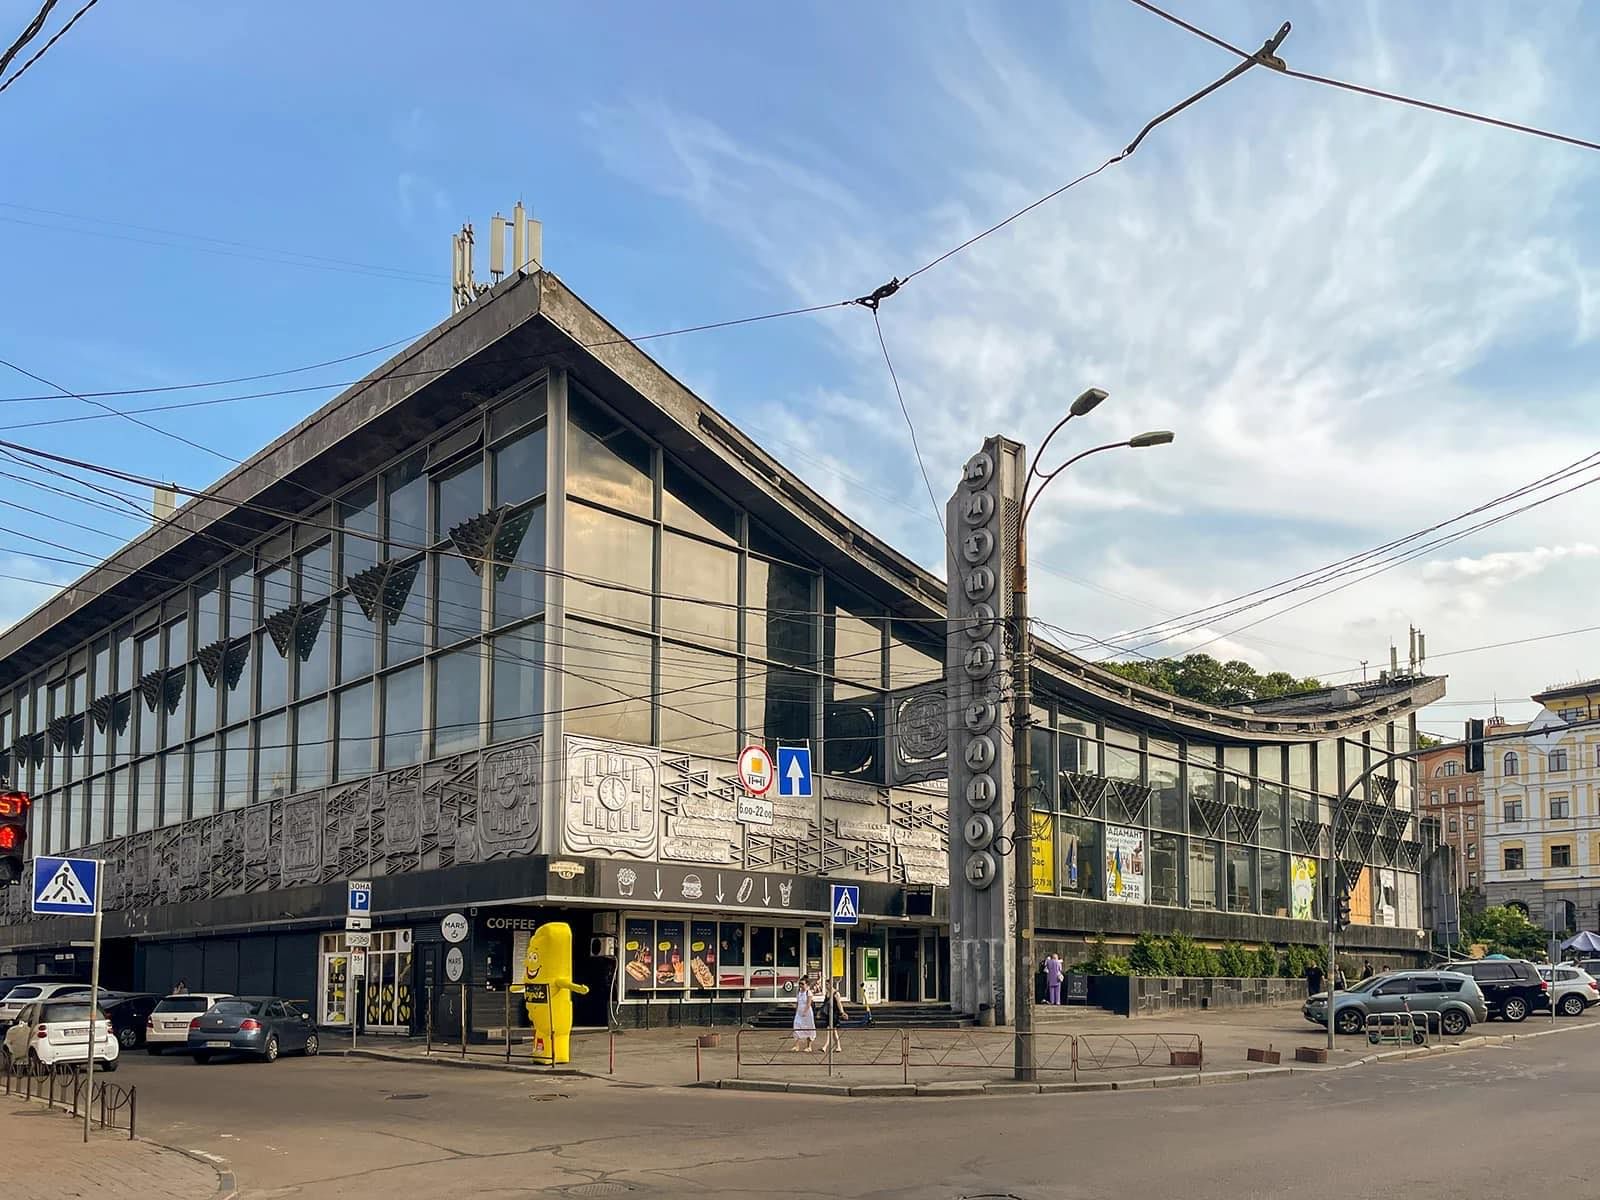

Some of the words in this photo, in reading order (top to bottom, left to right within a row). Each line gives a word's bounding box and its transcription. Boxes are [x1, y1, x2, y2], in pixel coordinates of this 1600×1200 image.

[968, 706, 986, 879] РИНОК
[350, 882, 370, 890] ЗОНА
[355, 892, 366, 909] P
[486, 917, 536, 930] COFFEE
